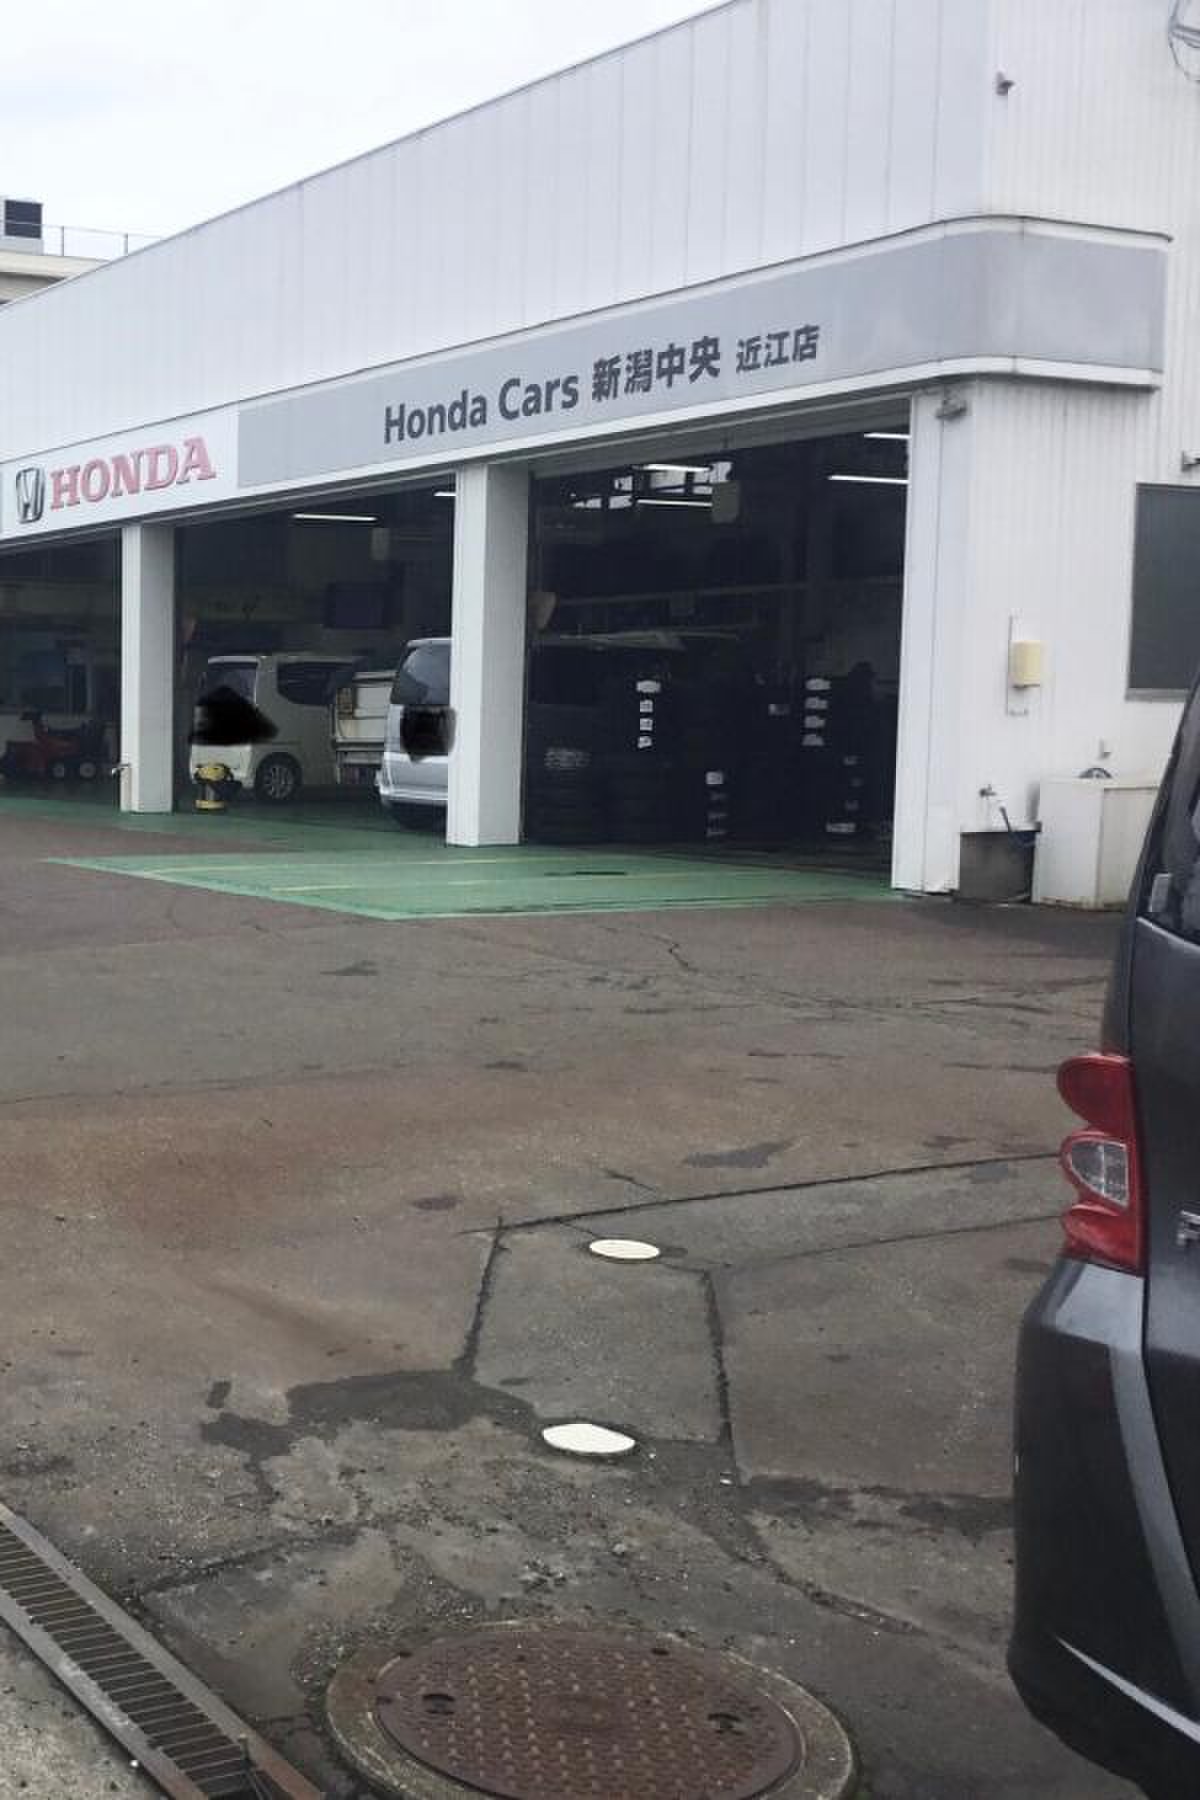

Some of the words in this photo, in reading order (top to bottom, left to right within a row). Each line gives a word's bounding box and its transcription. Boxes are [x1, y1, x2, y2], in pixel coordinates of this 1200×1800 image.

[592, 336, 721, 401] 新潟中央
[735, 325, 820, 373] 近江店
[384, 389, 487, 443] Honda
[500, 373, 579, 420] Cars
[50, 435, 217, 510] HONDA
